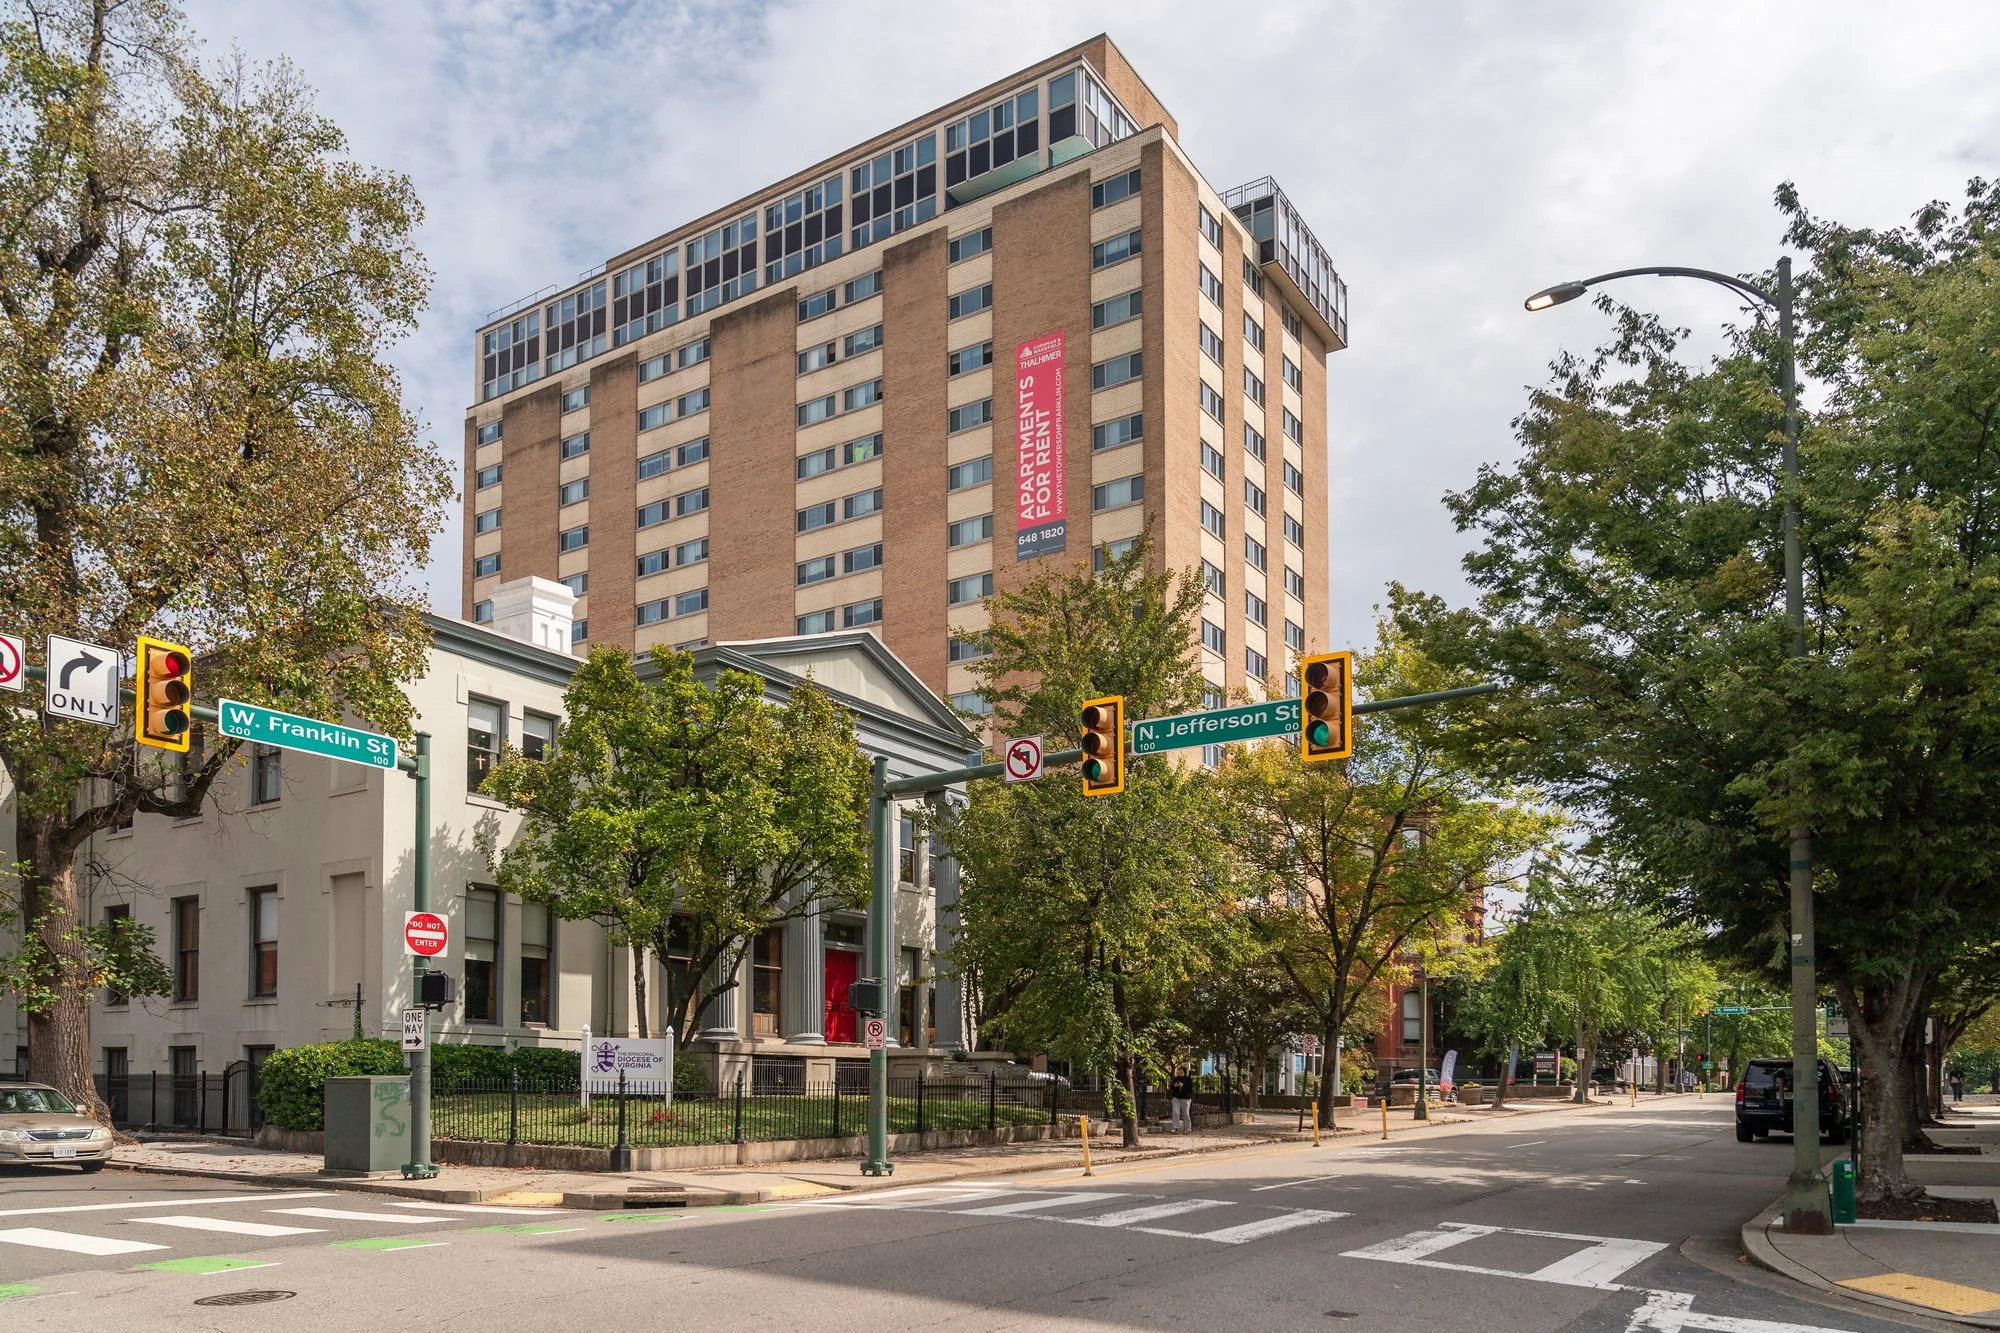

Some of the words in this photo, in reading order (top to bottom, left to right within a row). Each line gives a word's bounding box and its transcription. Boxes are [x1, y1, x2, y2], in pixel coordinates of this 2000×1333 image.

[1033, 342, 1061, 354] WAKEFIELD
[1020, 350, 1061, 370] THALHIMER
[1035, 409, 1051, 466] RENT
[1019, 375, 1035, 520] APARTMENTS
[1036, 469, 1051, 518] FOR
[1018, 532, 1038, 545] 648
[1040, 526, 1064, 540] 1820
[51, 692, 114, 721] ONLY
[1139, 725, 1159, 742] N.
[1165, 709, 1268, 738] Jefferson
[1275, 704, 1300, 721] St
[1284, 722, 1299, 733] 00
[228, 706, 260, 729] W.
[269, 716, 359, 750] Franklin
[366, 738, 390, 756] St
[228, 725, 252, 738] 200
[1139, 741, 1155, 752] 100
[372, 755, 389, 766] 100
[412, 920, 423, 929] DO
[426, 922, 441, 930] NOT
[415, 939, 438, 948] ENTER
[405, 1012, 423, 1023] ONE
[404, 1024, 423, 1034] WAY
